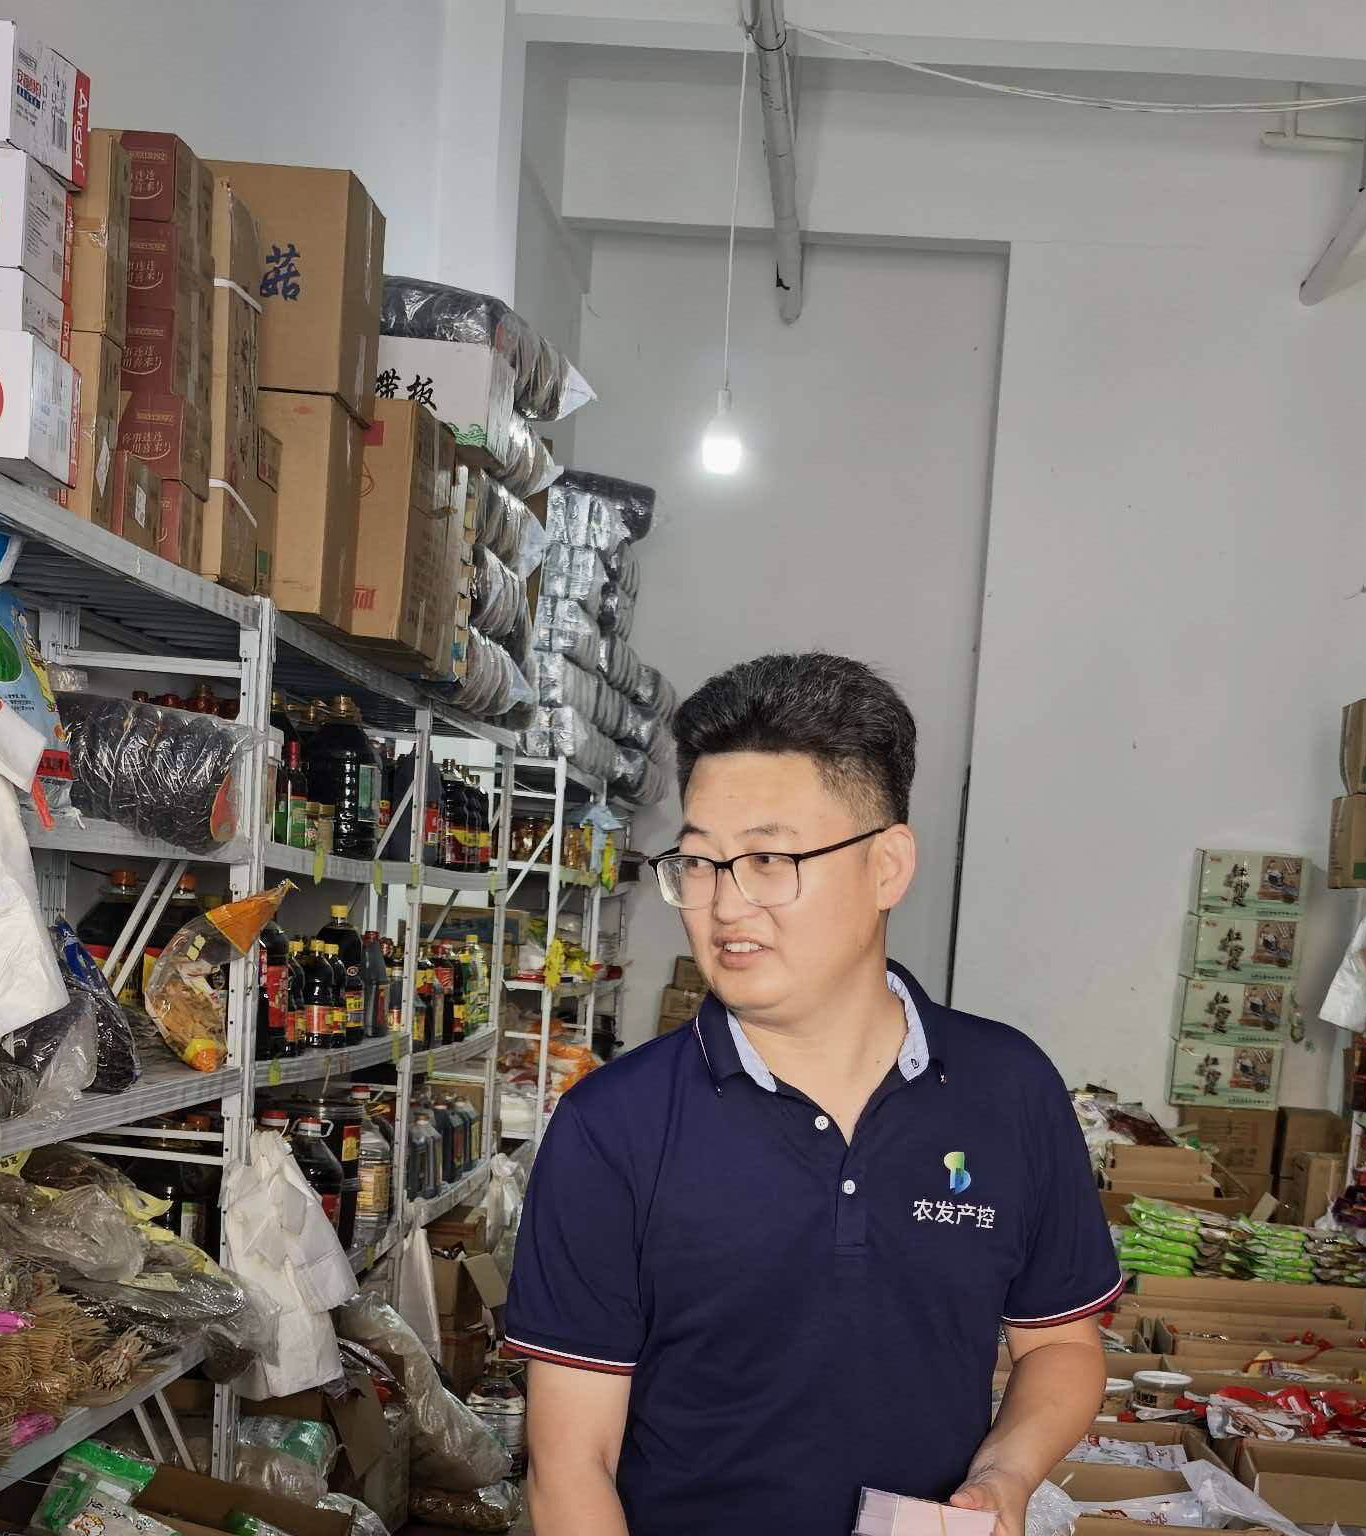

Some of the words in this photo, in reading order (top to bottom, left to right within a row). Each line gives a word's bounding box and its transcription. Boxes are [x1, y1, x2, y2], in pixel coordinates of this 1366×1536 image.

[74, 88, 88, 168] Angel
[260, 243, 302, 301] 菇
[913, 1199, 995, 1229] 农发产控
